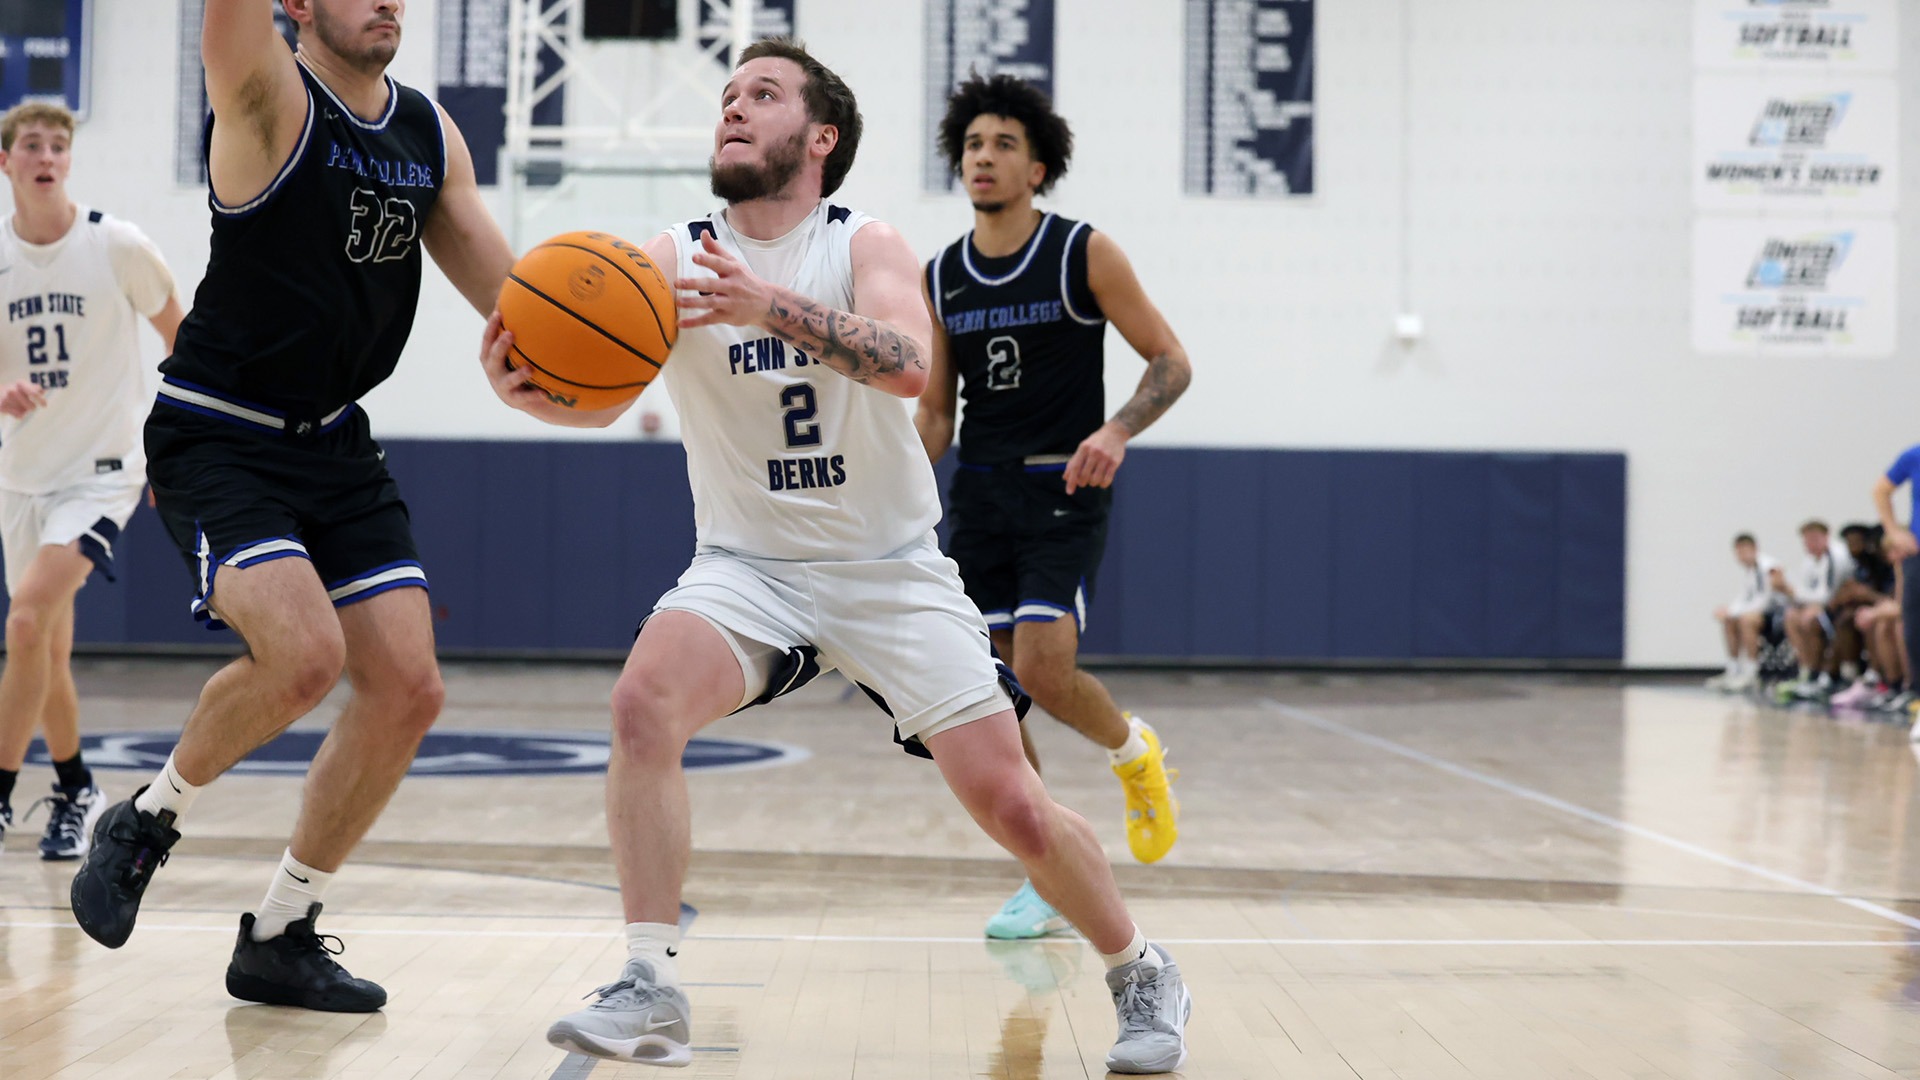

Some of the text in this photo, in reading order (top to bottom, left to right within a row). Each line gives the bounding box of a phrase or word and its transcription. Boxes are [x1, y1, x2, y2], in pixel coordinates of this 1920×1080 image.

[344, 186, 417, 263] 32
[8, 292, 85, 324] PENN STATE
[945, 300, 1063, 336] PENN COLLEGE
[26, 323, 70, 365] 21
[729, 337, 786, 375] PENN
[986, 335, 1021, 390] 2
[779, 381, 822, 449] 2
[767, 454, 846, 491] BERKS
